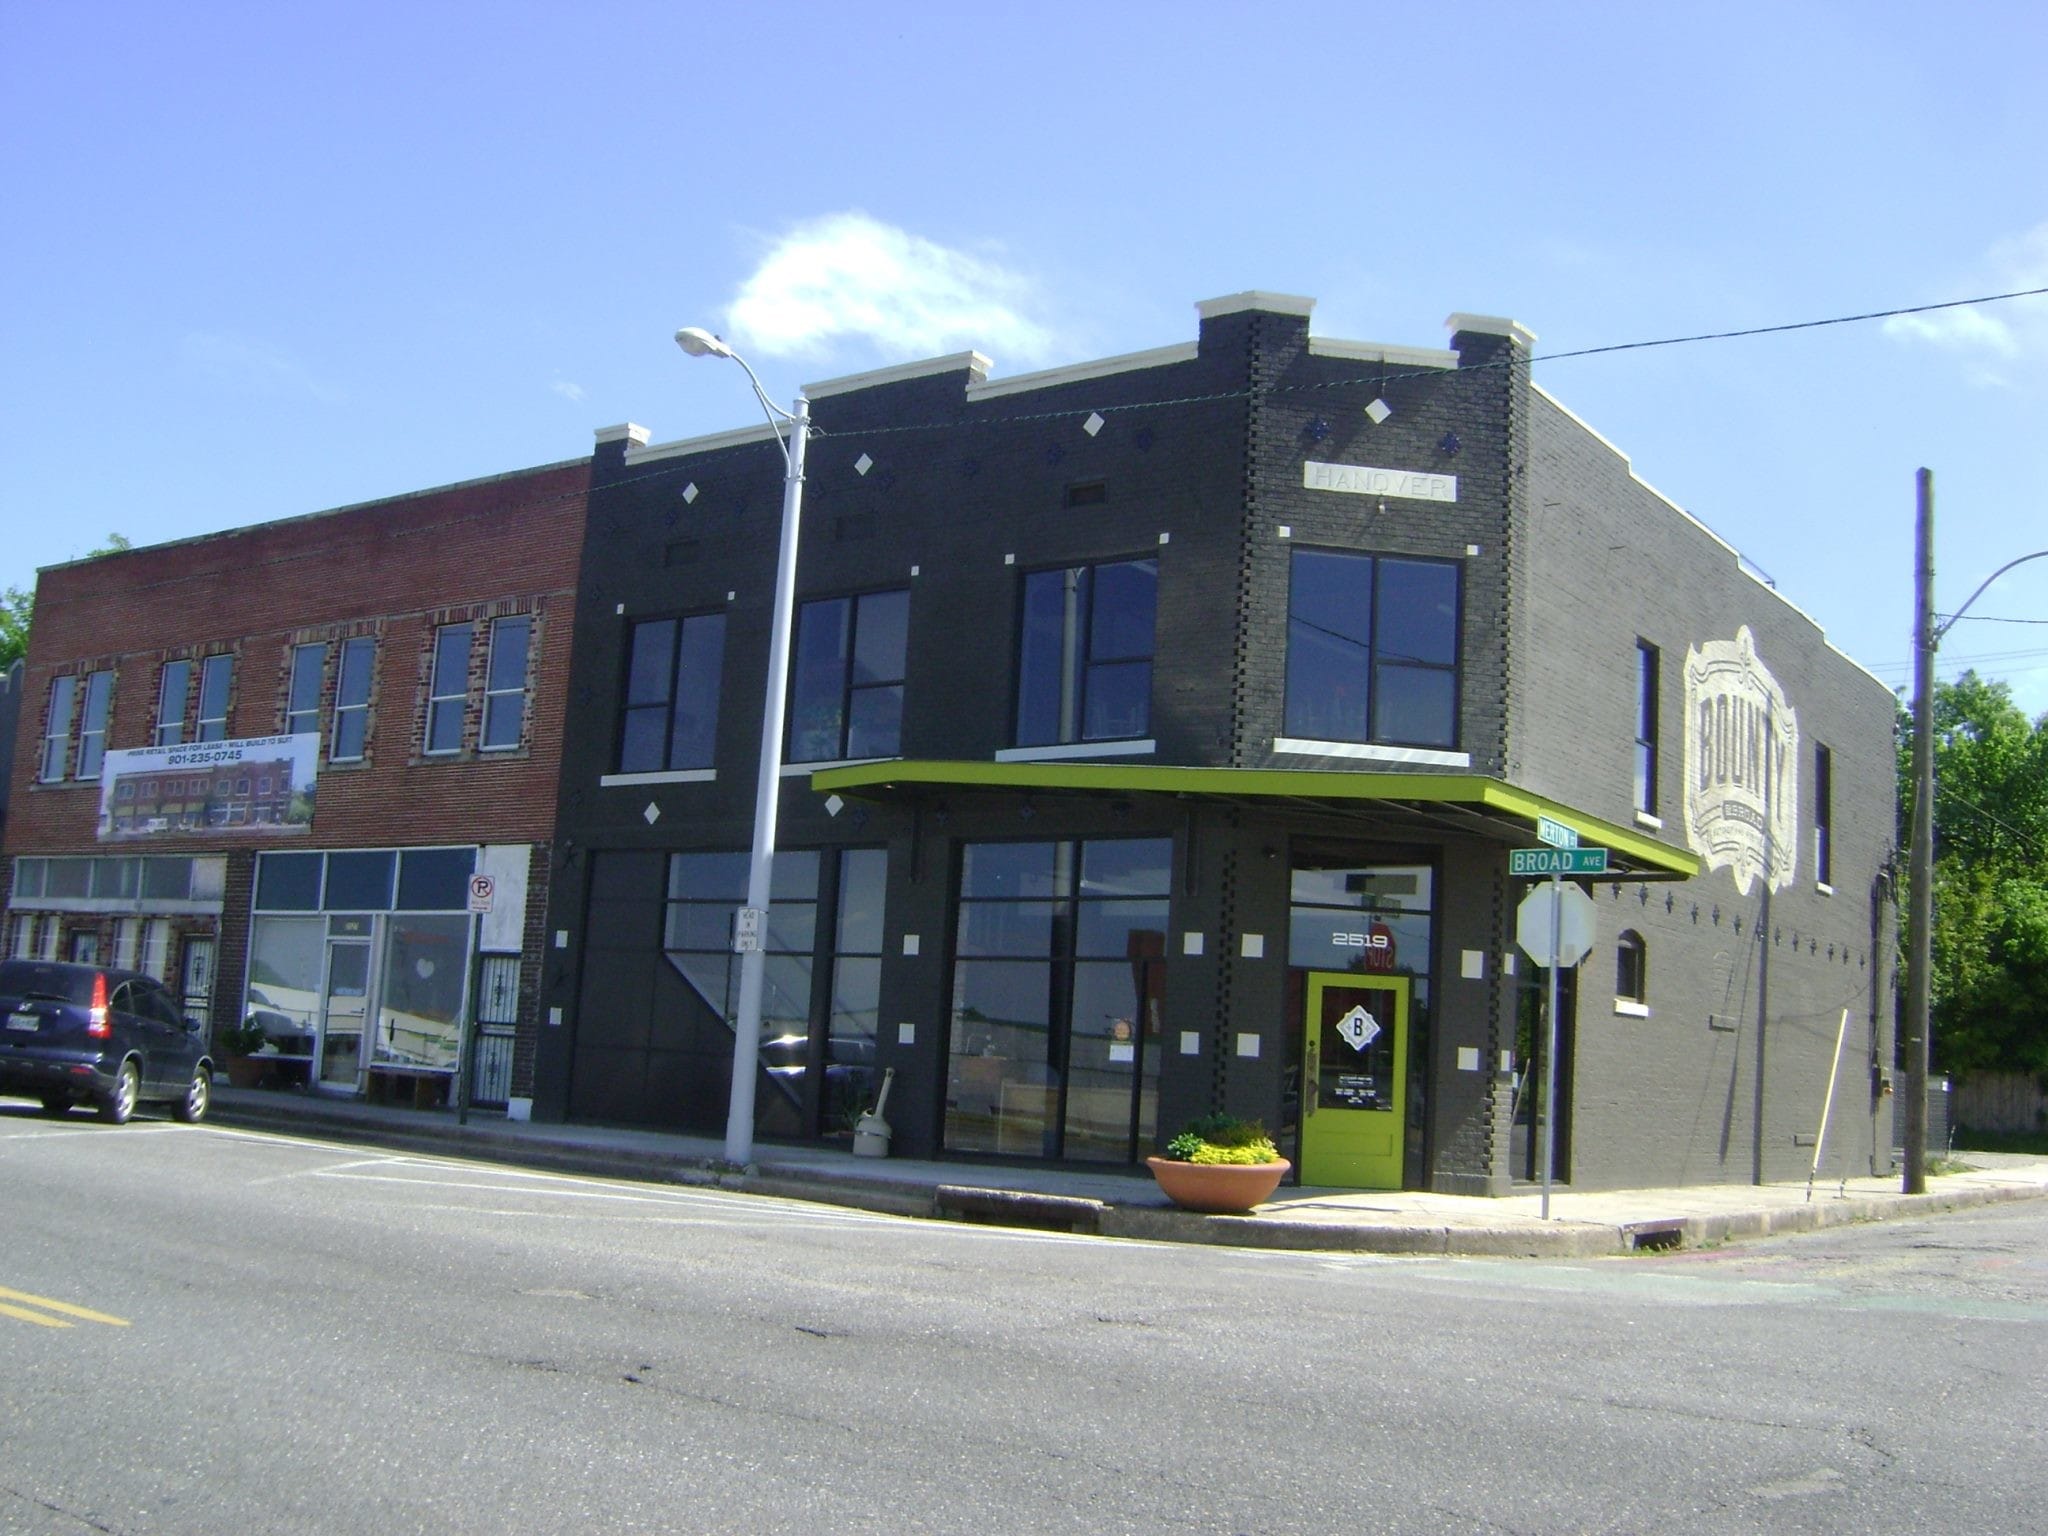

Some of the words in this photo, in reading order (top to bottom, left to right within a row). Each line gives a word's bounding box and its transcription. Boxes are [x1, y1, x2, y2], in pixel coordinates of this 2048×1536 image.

[1314, 467, 1449, 498] HANOVER
[203, 742, 223, 751] LEASE
[228, 740, 244, 748] WILL
[246, 738, 266, 747] BUILD
[277, 736, 293, 744] SUIT
[168, 749, 242, 765] 901-235-0745
[1540, 816, 1568, 848] MERTON
[1514, 851, 1573, 872] BROAD
[1582, 855, 1602, 867] AVE
[1353, 1017, 1363, 1037] B
